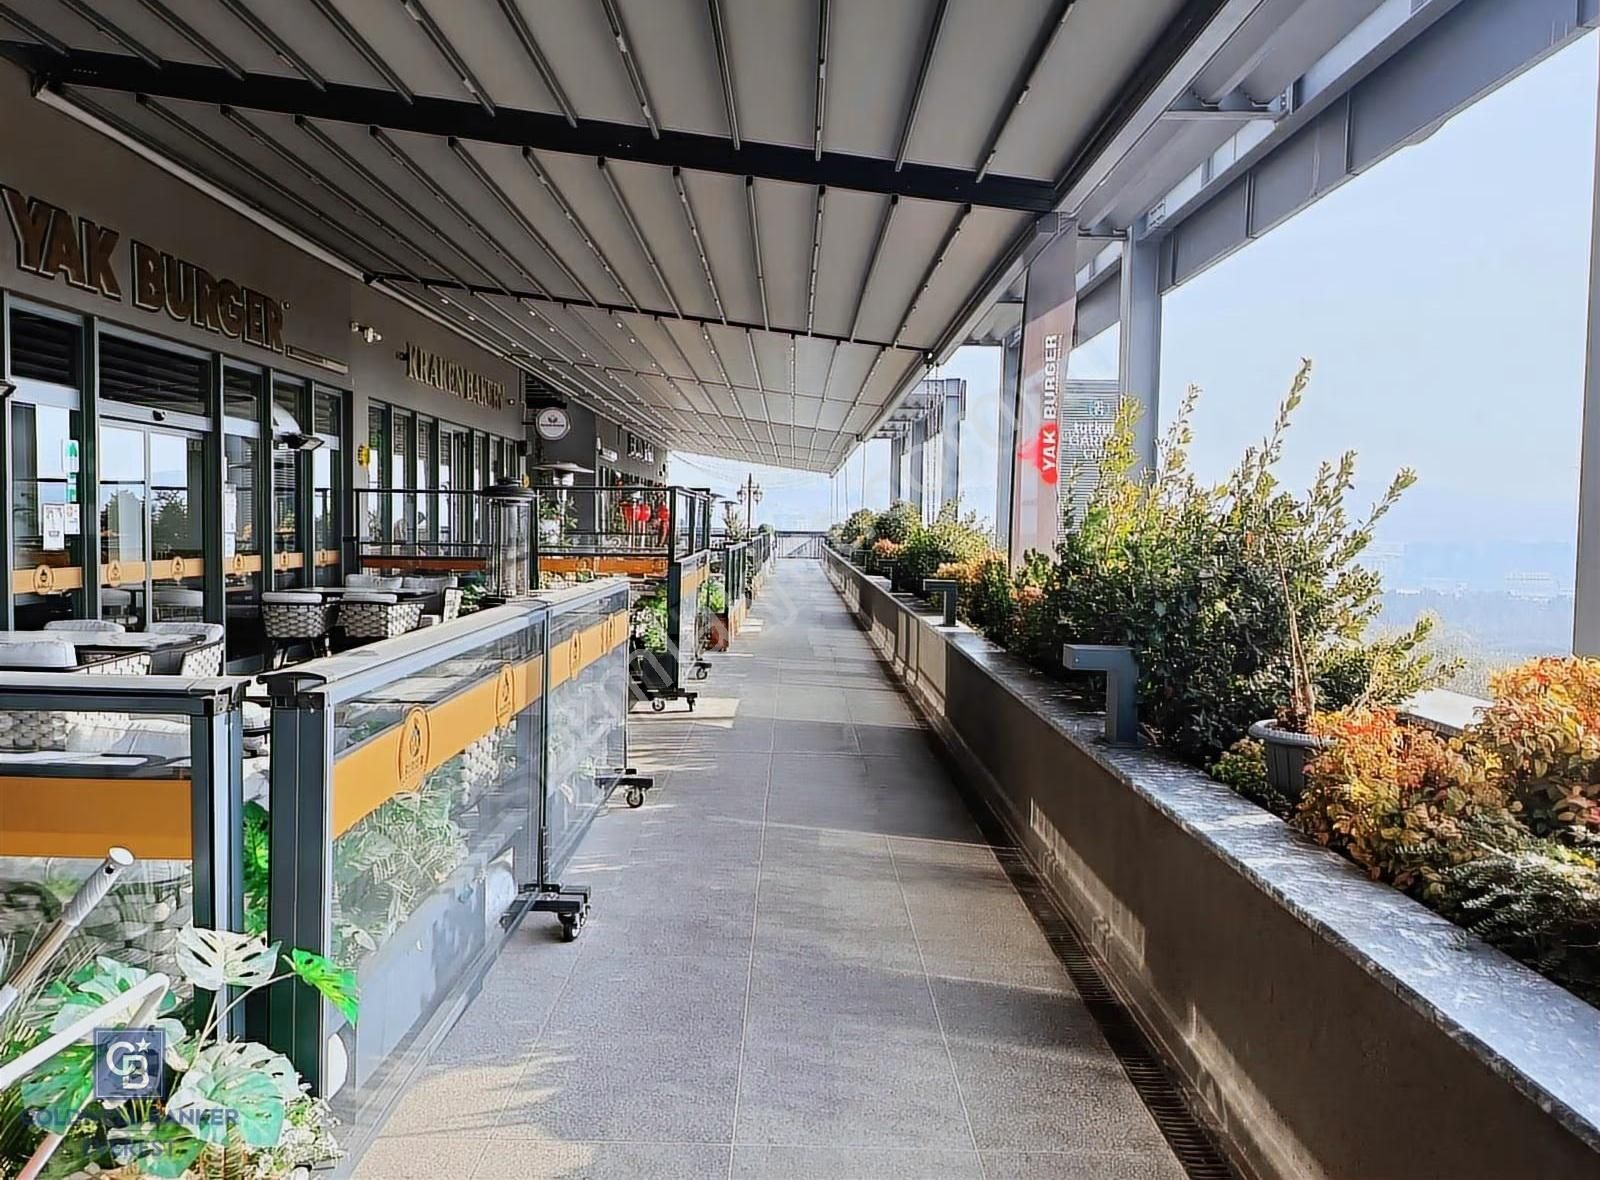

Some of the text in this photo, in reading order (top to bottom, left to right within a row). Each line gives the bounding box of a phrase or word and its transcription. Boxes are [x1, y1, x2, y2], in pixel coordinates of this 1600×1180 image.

[0, 184, 285, 354] YAK BURGER
[407, 345, 465, 399] KRAKEN
[1043, 334, 1058, 472] YAK BURGER
